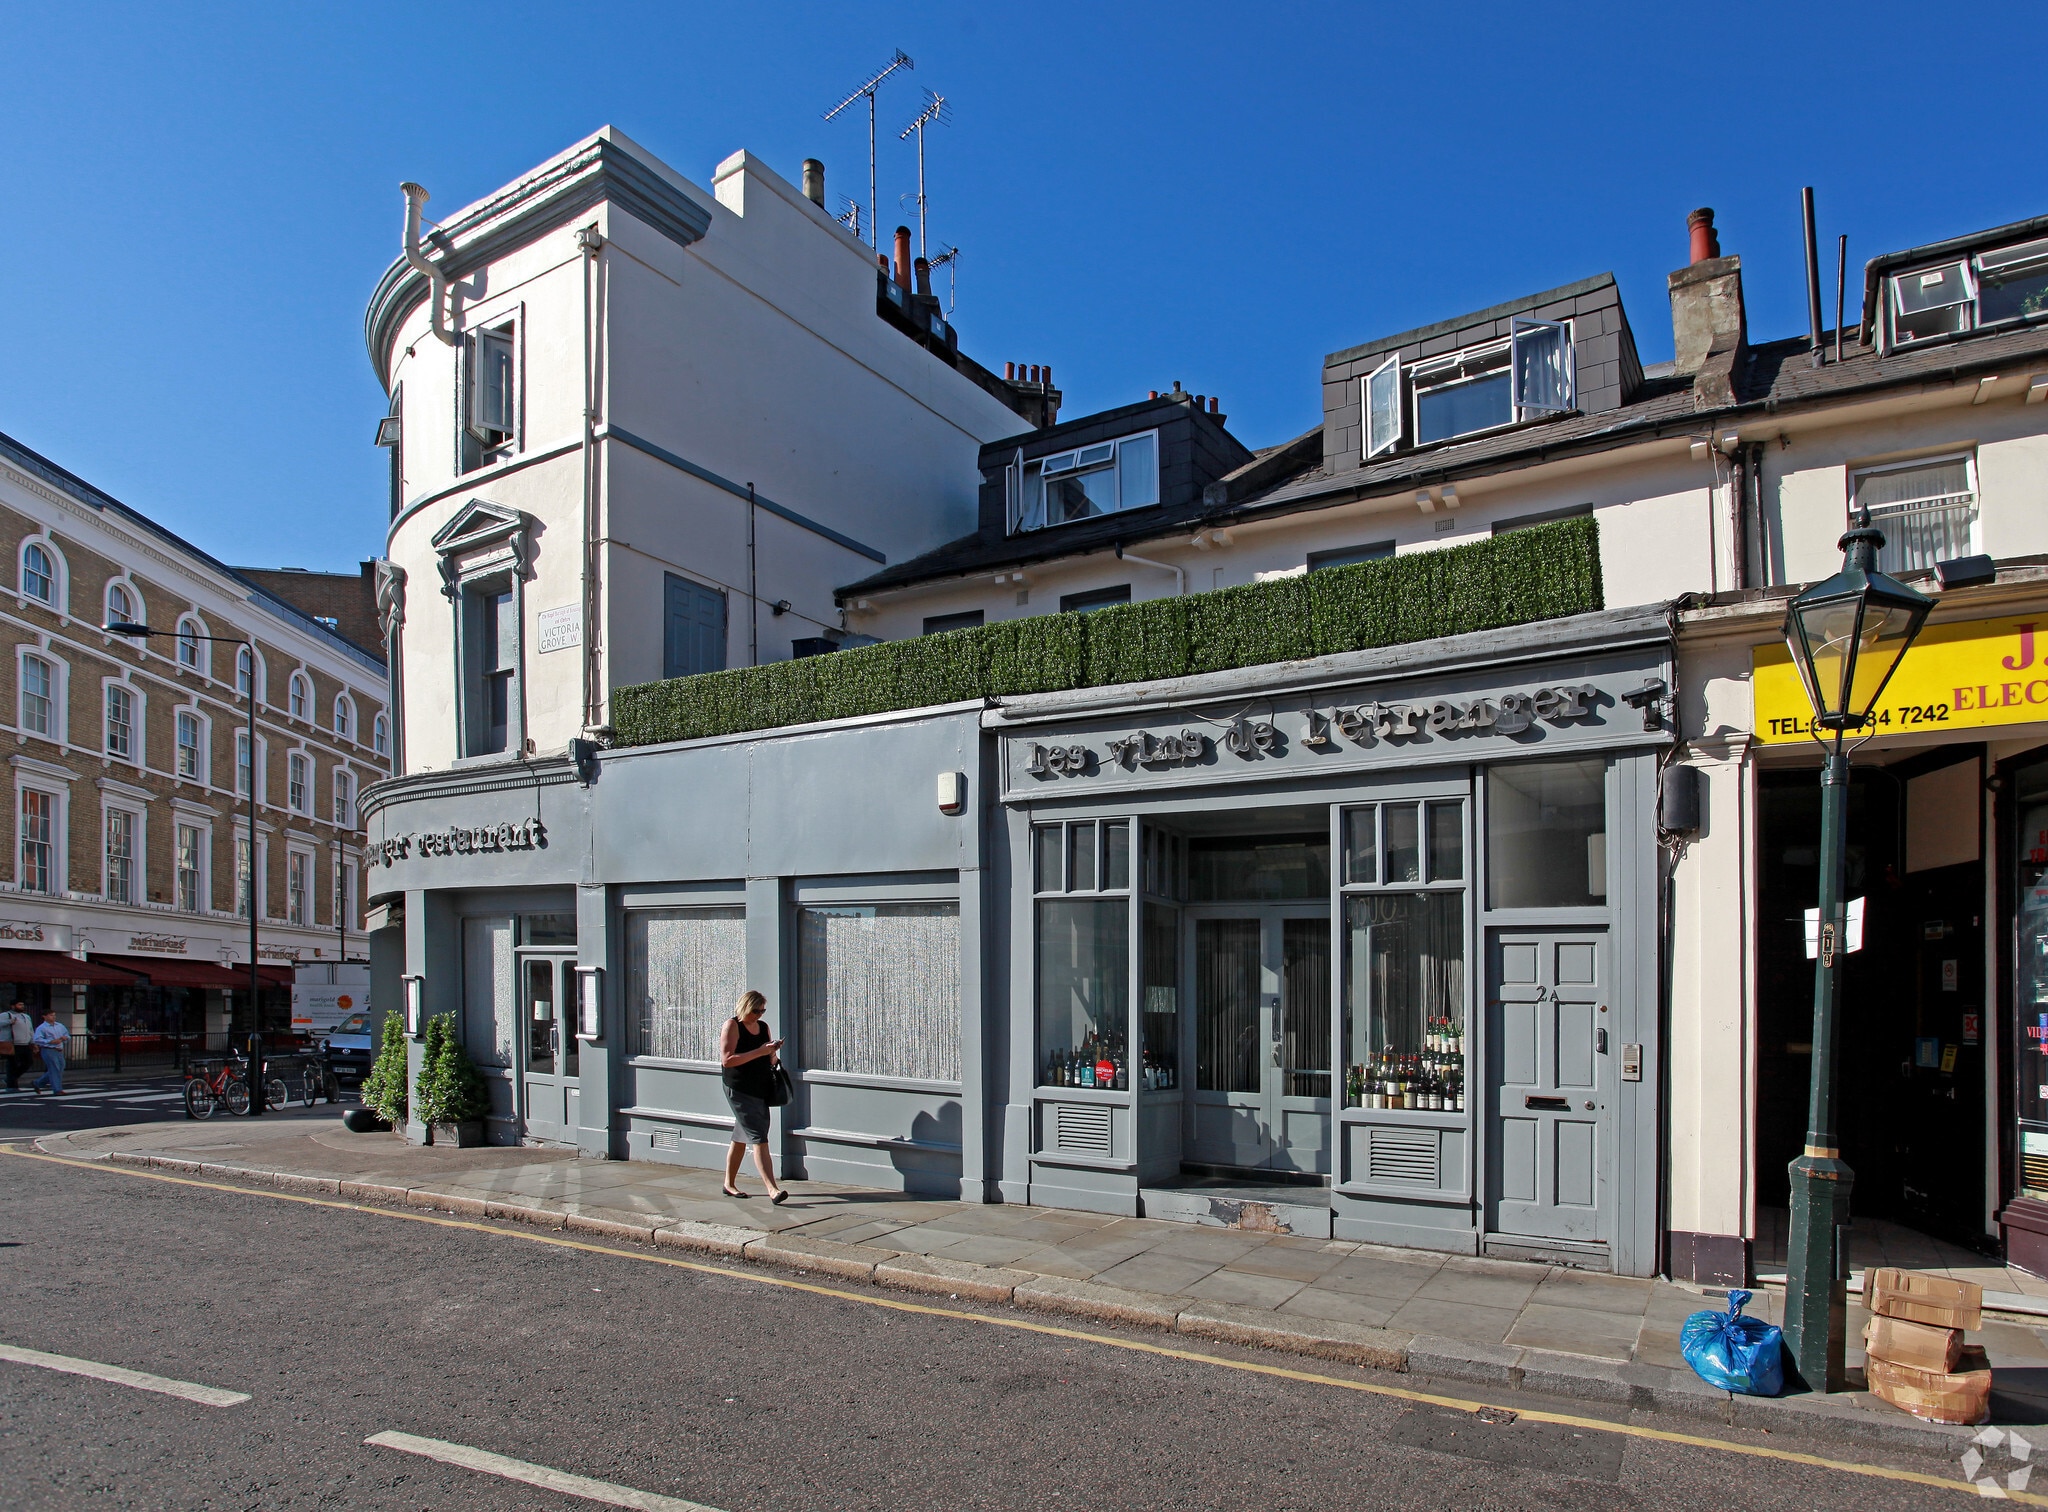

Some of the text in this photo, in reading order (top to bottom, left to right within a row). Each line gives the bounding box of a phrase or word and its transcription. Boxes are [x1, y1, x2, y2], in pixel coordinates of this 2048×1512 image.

[544, 622, 580, 637] VICTORIA
[1952, 680, 2048, 711] ELEC
[1899, 703, 1949, 724] 7242
[1025, 741, 1085, 774] les
[1105, 729, 1203, 765] vins
[1225, 718, 1273, 752] de
[417, 817, 540, 852] restaurant
[1536, 986, 1560, 1002] 2A
